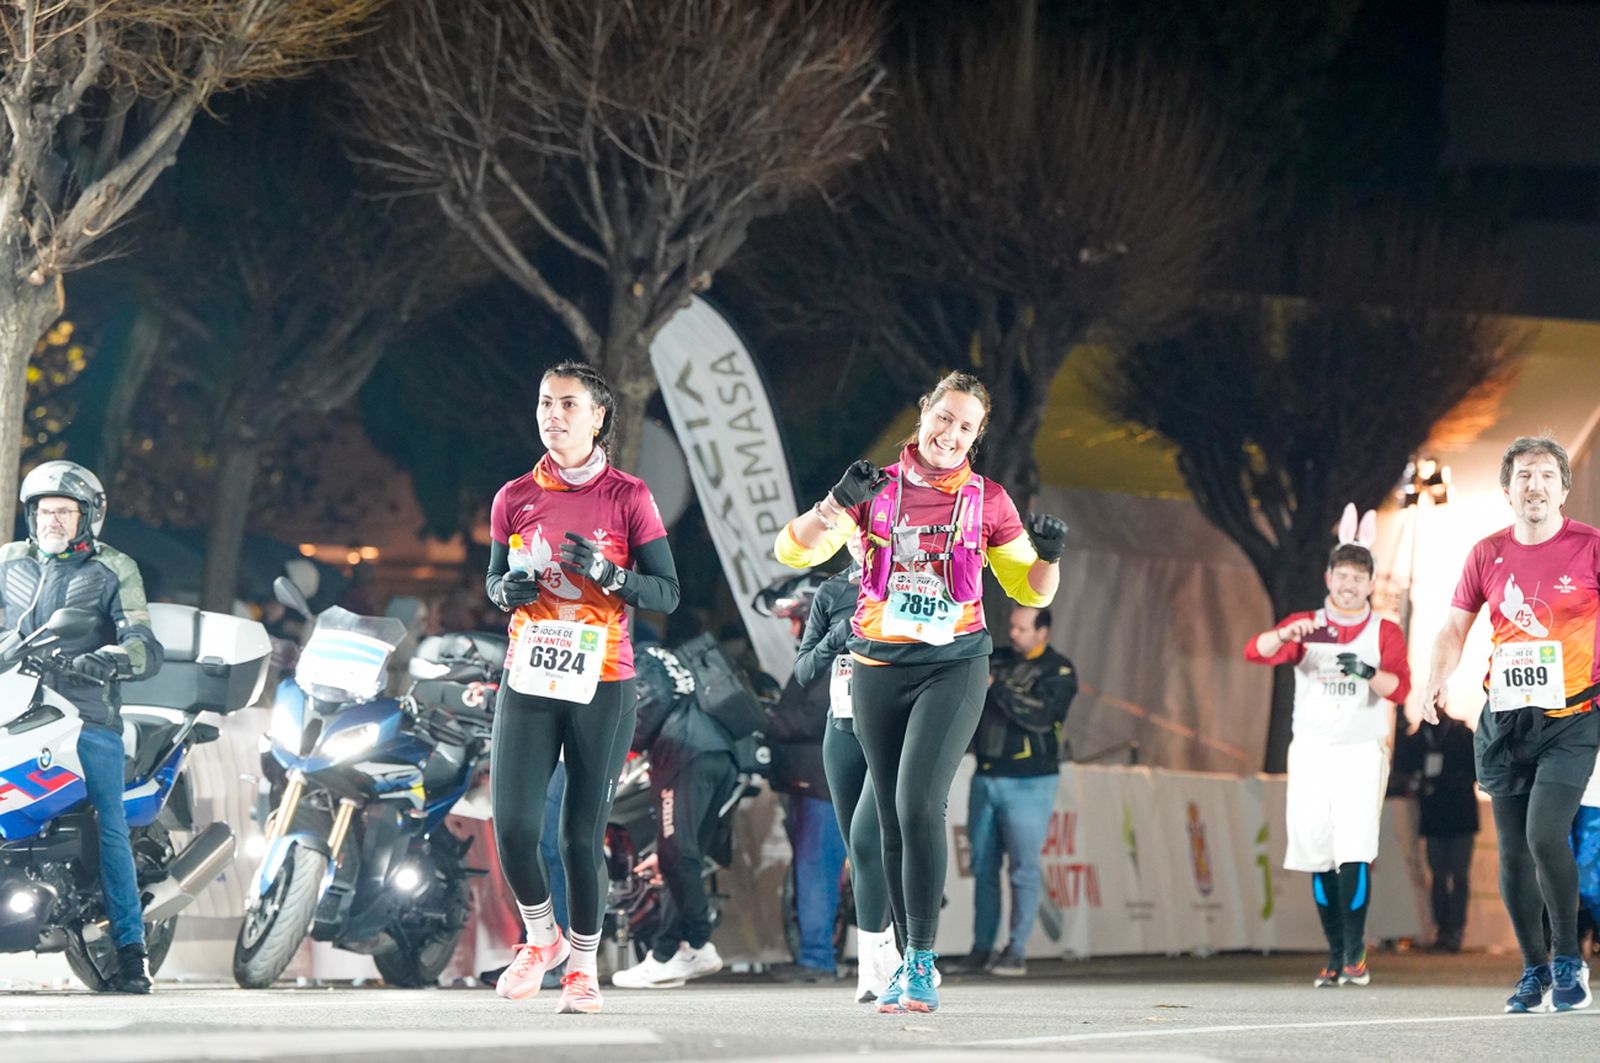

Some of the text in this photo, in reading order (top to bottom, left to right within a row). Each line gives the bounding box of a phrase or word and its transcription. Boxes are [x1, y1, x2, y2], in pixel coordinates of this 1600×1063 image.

[542, 566, 562, 589] 43
[1515, 608, 1533, 628] 43
[529, 645, 586, 675] 6324
[1502, 666, 1548, 688] 1689
[1322, 681, 1357, 696] 7009
